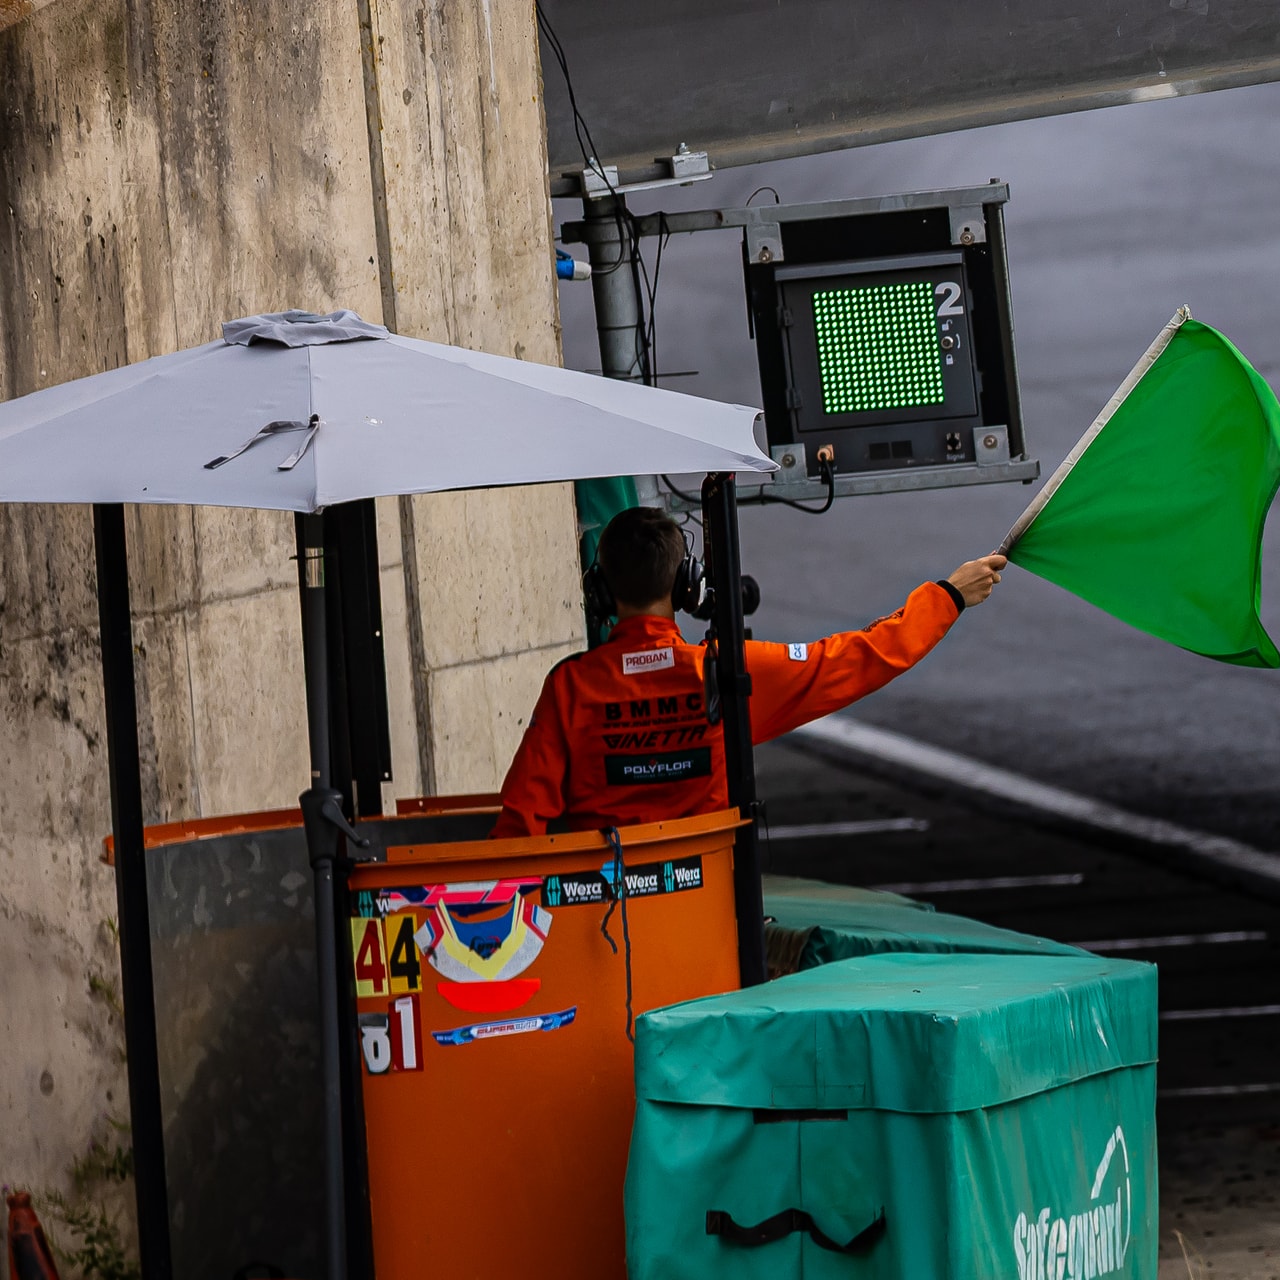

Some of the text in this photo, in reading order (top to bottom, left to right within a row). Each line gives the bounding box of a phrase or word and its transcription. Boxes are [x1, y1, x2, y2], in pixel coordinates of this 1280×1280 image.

[934, 281, 964, 317] 2
[625, 651, 668, 667] PROBAN
[623, 760, 692, 775] POLYFLOR
[625, 874, 658, 890] Wera
[674, 868, 701, 883] Wera
[563, 882, 602, 897] Wera
